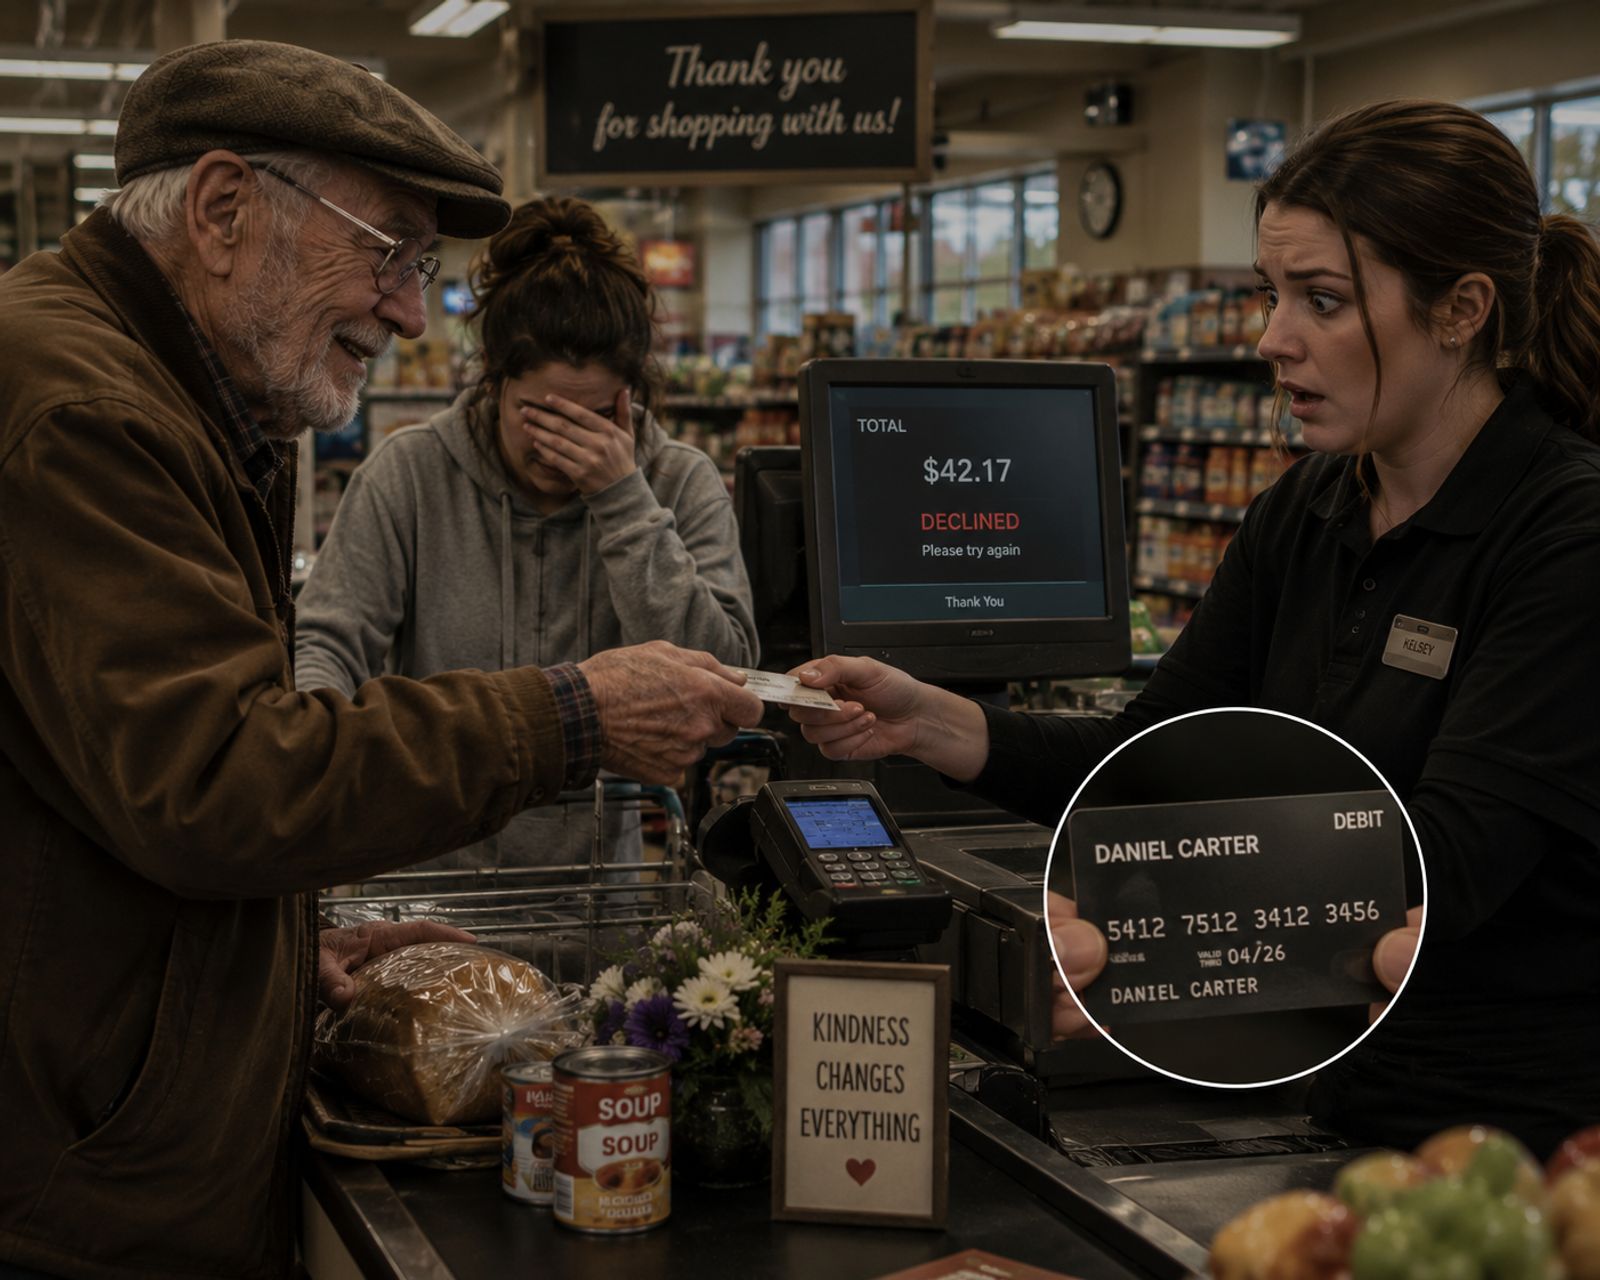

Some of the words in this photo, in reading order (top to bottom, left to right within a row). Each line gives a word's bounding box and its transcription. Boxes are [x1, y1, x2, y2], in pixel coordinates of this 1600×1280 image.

[666, 41, 772, 88] Thank
[779, 57, 847, 101] you
[592, 102, 639, 152] for
[646, 101, 774, 151] shopping
[780, 97, 847, 135] with
[853, 97, 902, 134] us!
[856, 418, 907, 433] TOTAL
[923, 455, 1012, 485] $42.17
[920, 512, 1020, 531] DECLINED
[922, 543, 963, 556] Please
[966, 544, 984, 559] try
[986, 544, 1021, 559] again
[945, 595, 981, 608] Thank
[983, 595, 1005, 608] You
[1403, 640, 1435, 656] KELSEY
[1333, 809, 1384, 830] DEBIT
[1094, 840, 1174, 864] DANIEL
[1177, 834, 1260, 859] CARTER
[1106, 916, 1167, 942] 5412
[1181, 911, 1239, 936] 7512
[1253, 905, 1310, 930] 3412
[1325, 899, 1380, 924] 3456
[1227, 942, 1286, 965] 04/26
[1111, 983, 1180, 1005] DANIEL
[1190, 976, 1259, 998] CARTER
[813, 1012, 910, 1046] KINDNESS
[816, 1060, 905, 1094] CHANGES
[598, 1092, 662, 1120] SOUP
[800, 1107, 920, 1142] EVERYTHING
[602, 1132, 658, 1156] SOUP
